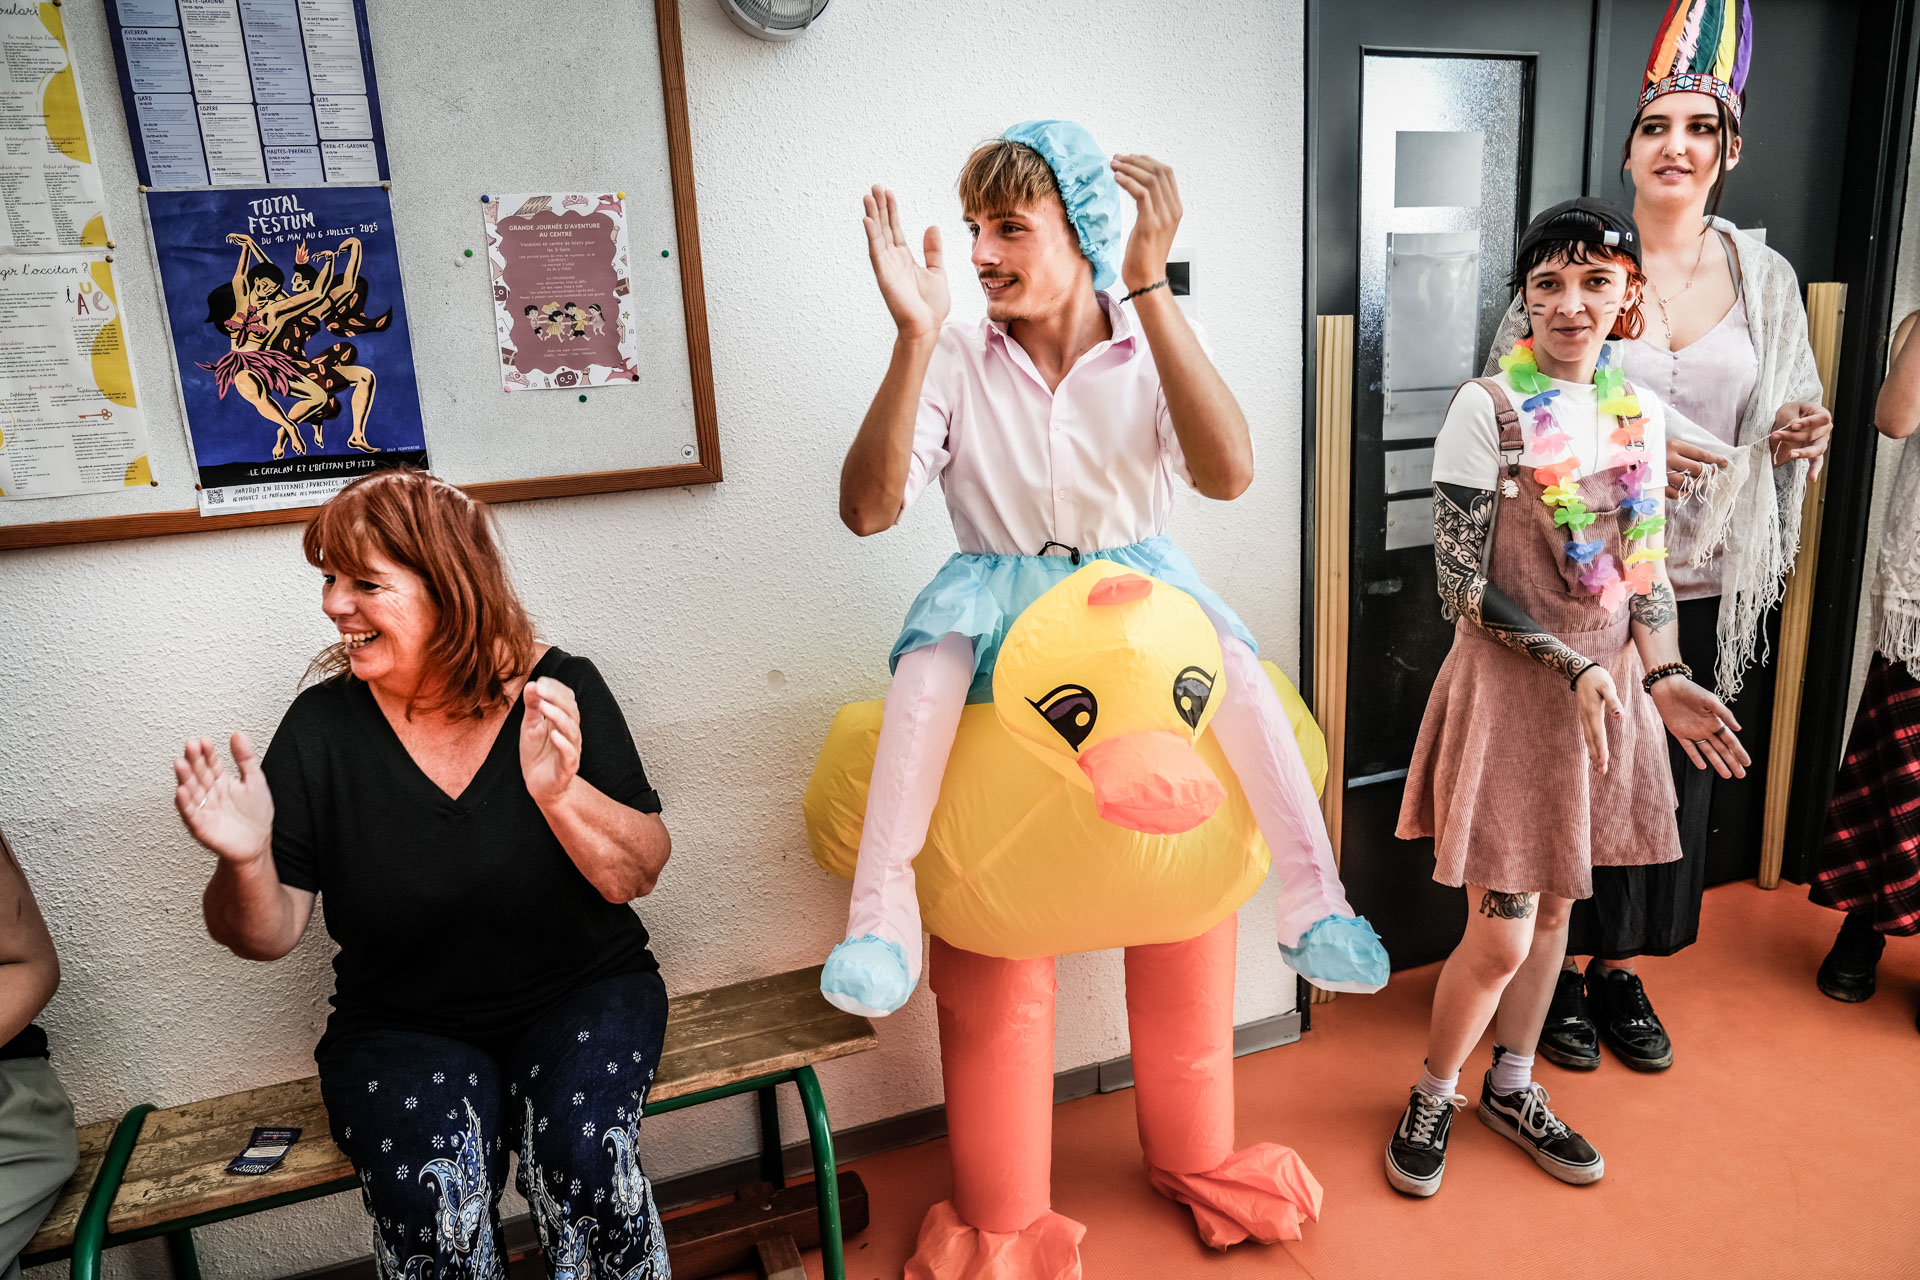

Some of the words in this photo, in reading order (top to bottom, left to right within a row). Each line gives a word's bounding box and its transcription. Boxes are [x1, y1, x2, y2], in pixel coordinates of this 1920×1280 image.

[248, 194, 305, 216] TOTAL
[248, 211, 316, 235] FESTUM
[261, 237, 271, 245] DU
[275, 235, 284, 243] 16
[287, 233, 301, 241] MAI
[306, 231, 316, 239] AU
[318, 230, 323, 238] 6
[326, 226, 355, 236] JUILLET
[359, 222, 378, 233] 2025
[535, 222, 562, 230] JOURNÉE
[564, 222, 600, 230] D'AVENTURE
[22, 263, 78, 275] l'occitan
[81, 262, 89, 273] ?
[77, 292, 90, 315] A
[249, 468, 260, 477] LE
[261, 464, 293, 475] CATALAN
[296, 462, 307, 472] ET
[308, 461, 344, 472] L'OCCITAN
[344, 460, 356, 469] EN
